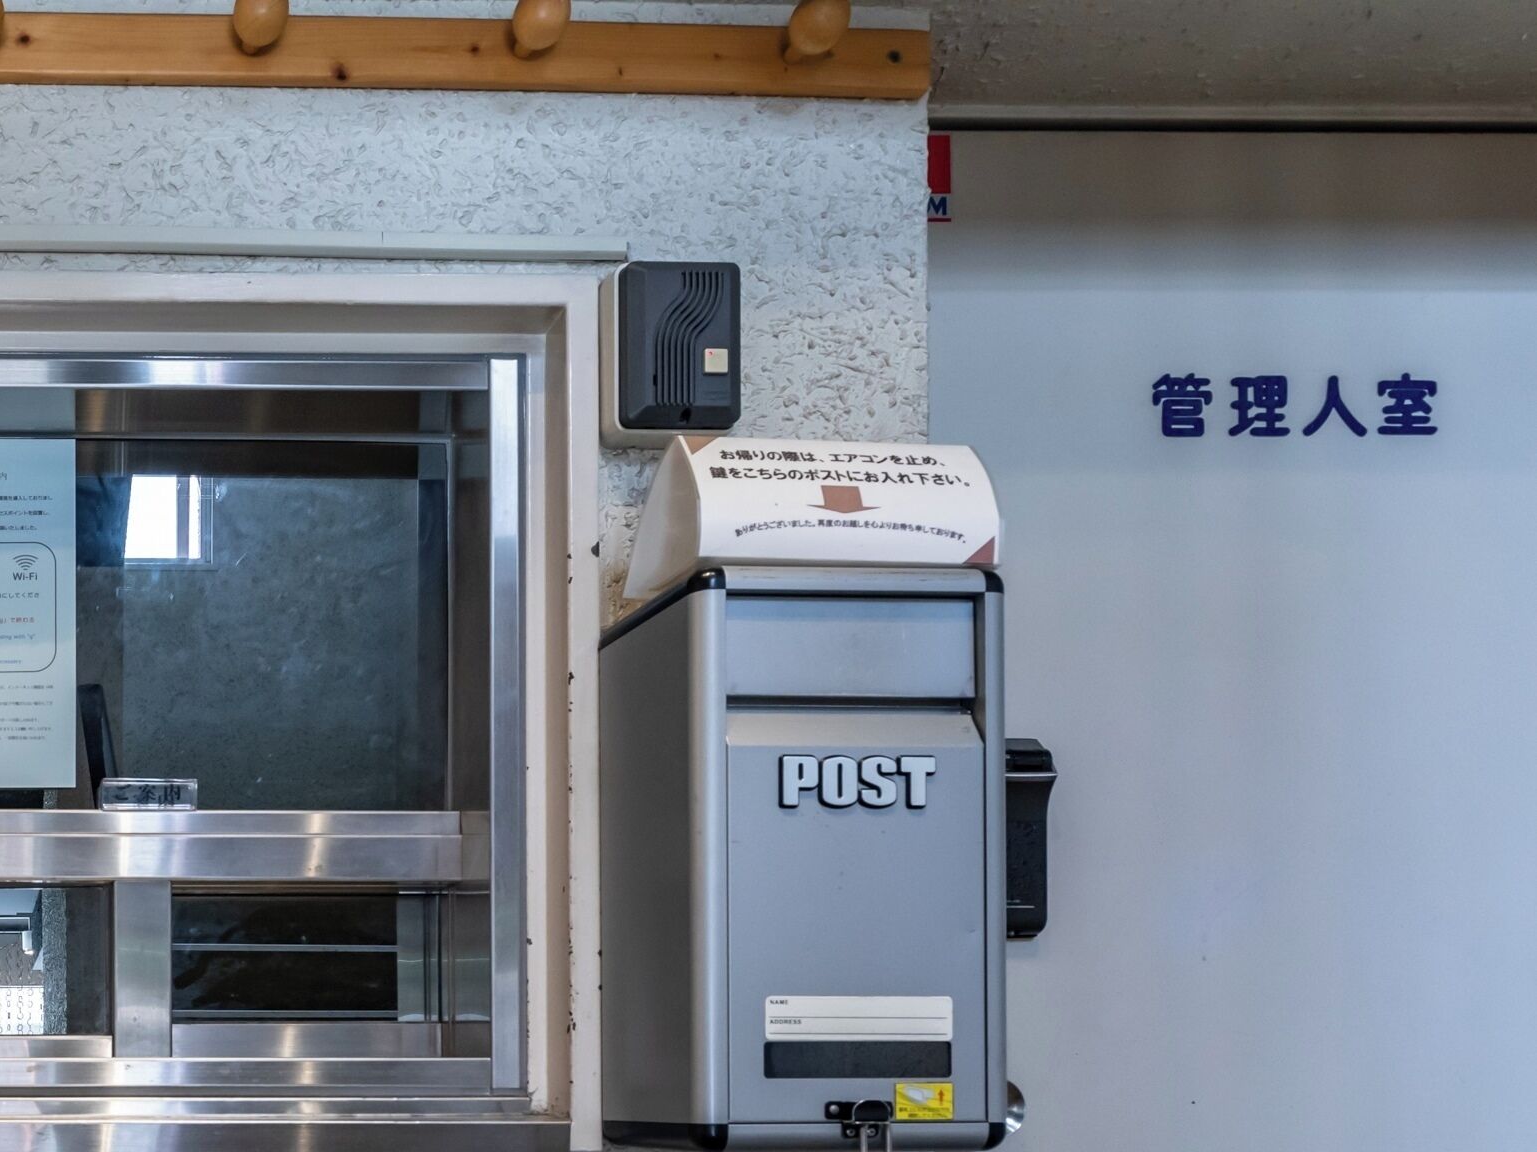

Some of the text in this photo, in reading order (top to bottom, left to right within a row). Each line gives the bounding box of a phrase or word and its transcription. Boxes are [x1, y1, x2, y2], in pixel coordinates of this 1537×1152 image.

[1151, 373, 1438, 437] 管理人室
[719, 448, 946, 467] お帰りの際は、エアコンを止め、
[710, 466, 971, 488] 鍵をこちらのポストにお入れ下さい。
[13, 572, 38, 580] Wi-Fi
[779, 754, 936, 808] POST
